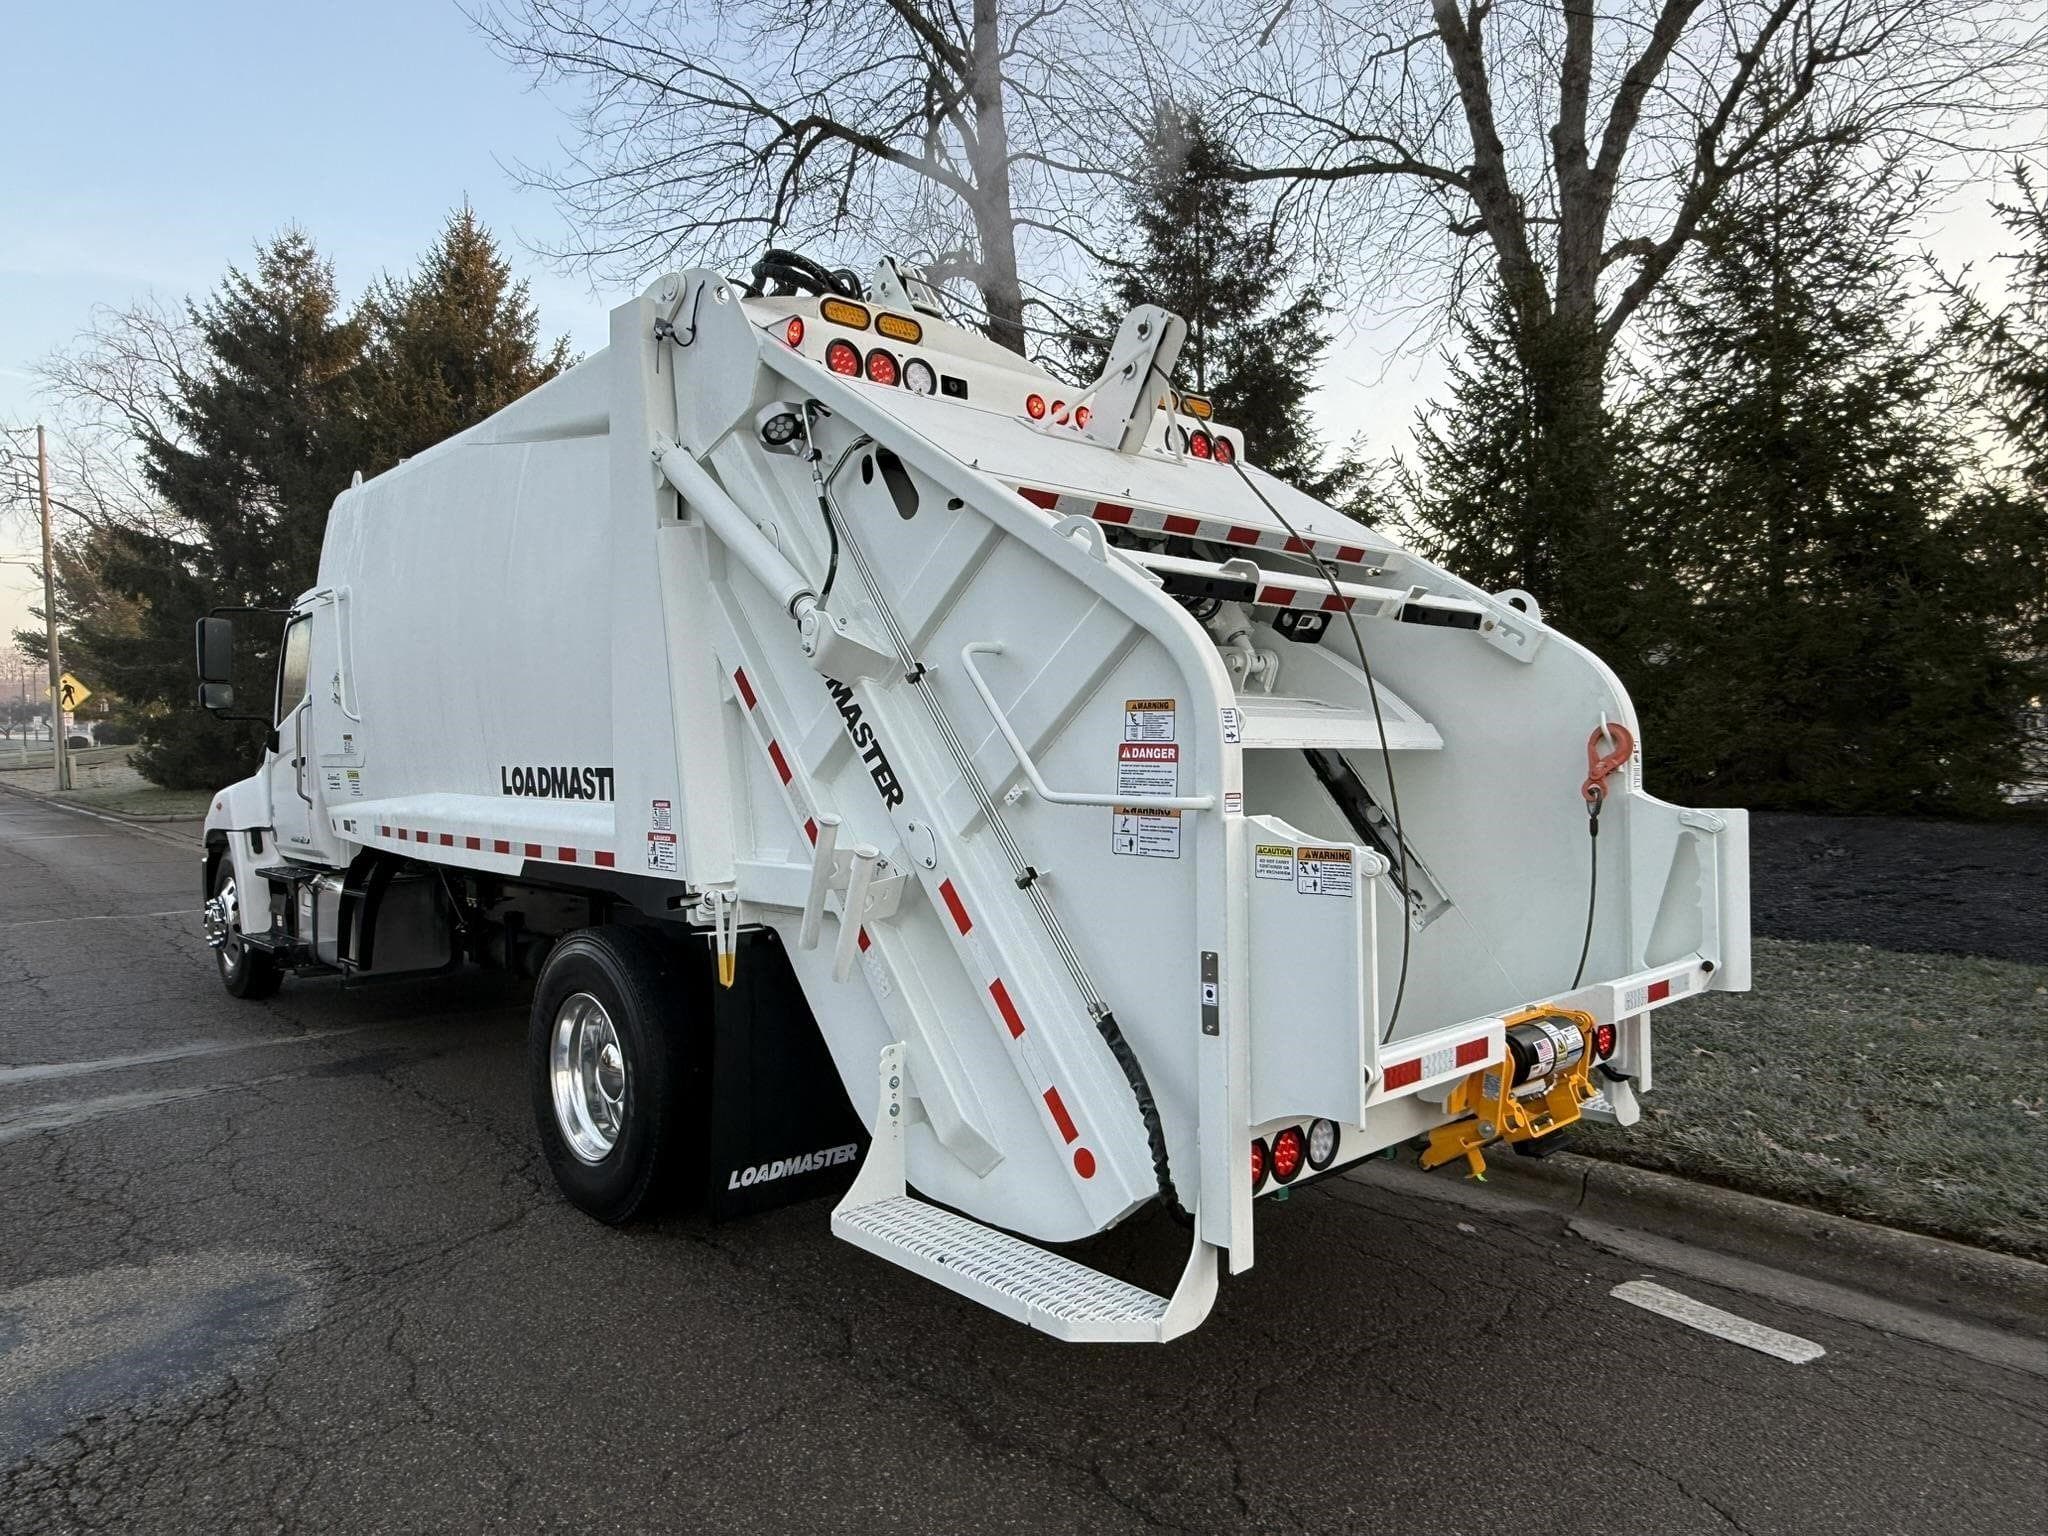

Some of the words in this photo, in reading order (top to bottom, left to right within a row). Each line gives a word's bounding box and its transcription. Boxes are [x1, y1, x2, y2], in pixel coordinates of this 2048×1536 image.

[1137, 701, 1169, 710] WARNING
[821, 674, 904, 812] MASTER
[1131, 747, 1176, 759] DANGER
[1262, 847, 1292, 856] CAUTION
[1310, 850, 1350, 860] WARNING
[728, 1143, 858, 1190] LOADMASTER
